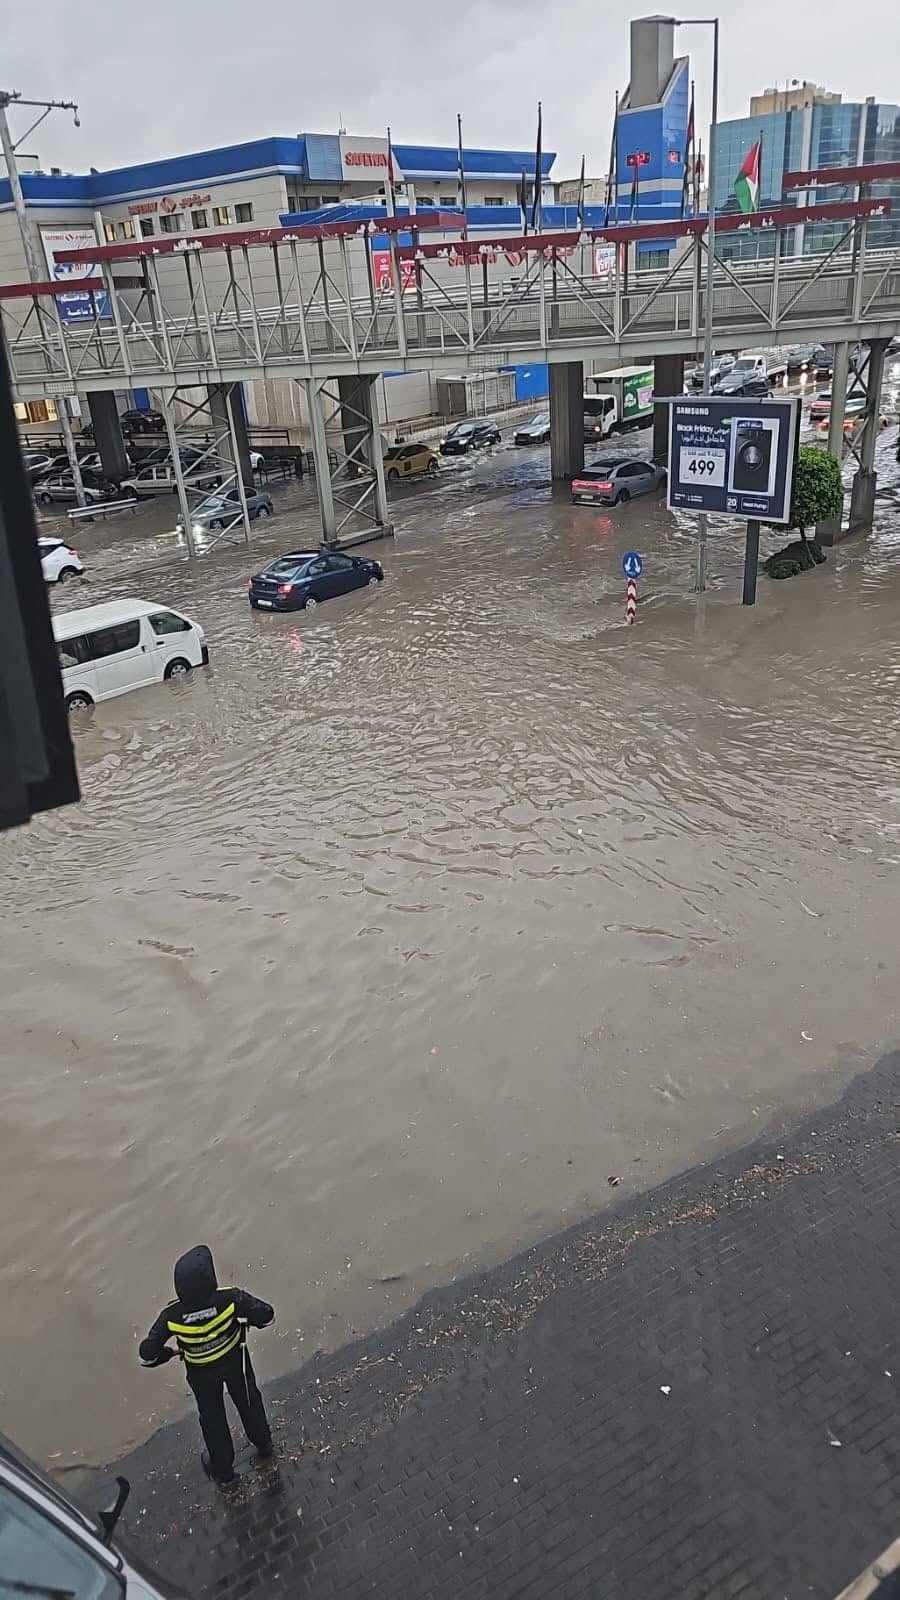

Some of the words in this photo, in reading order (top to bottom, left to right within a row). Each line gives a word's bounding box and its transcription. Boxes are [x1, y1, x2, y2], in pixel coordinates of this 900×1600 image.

[676, 406, 709, 415] SAMSUNG
[677, 423, 693, 432] Black
[694, 424, 714, 434] Friday
[688, 459, 715, 476] 499
[728, 498, 737, 507] 20
